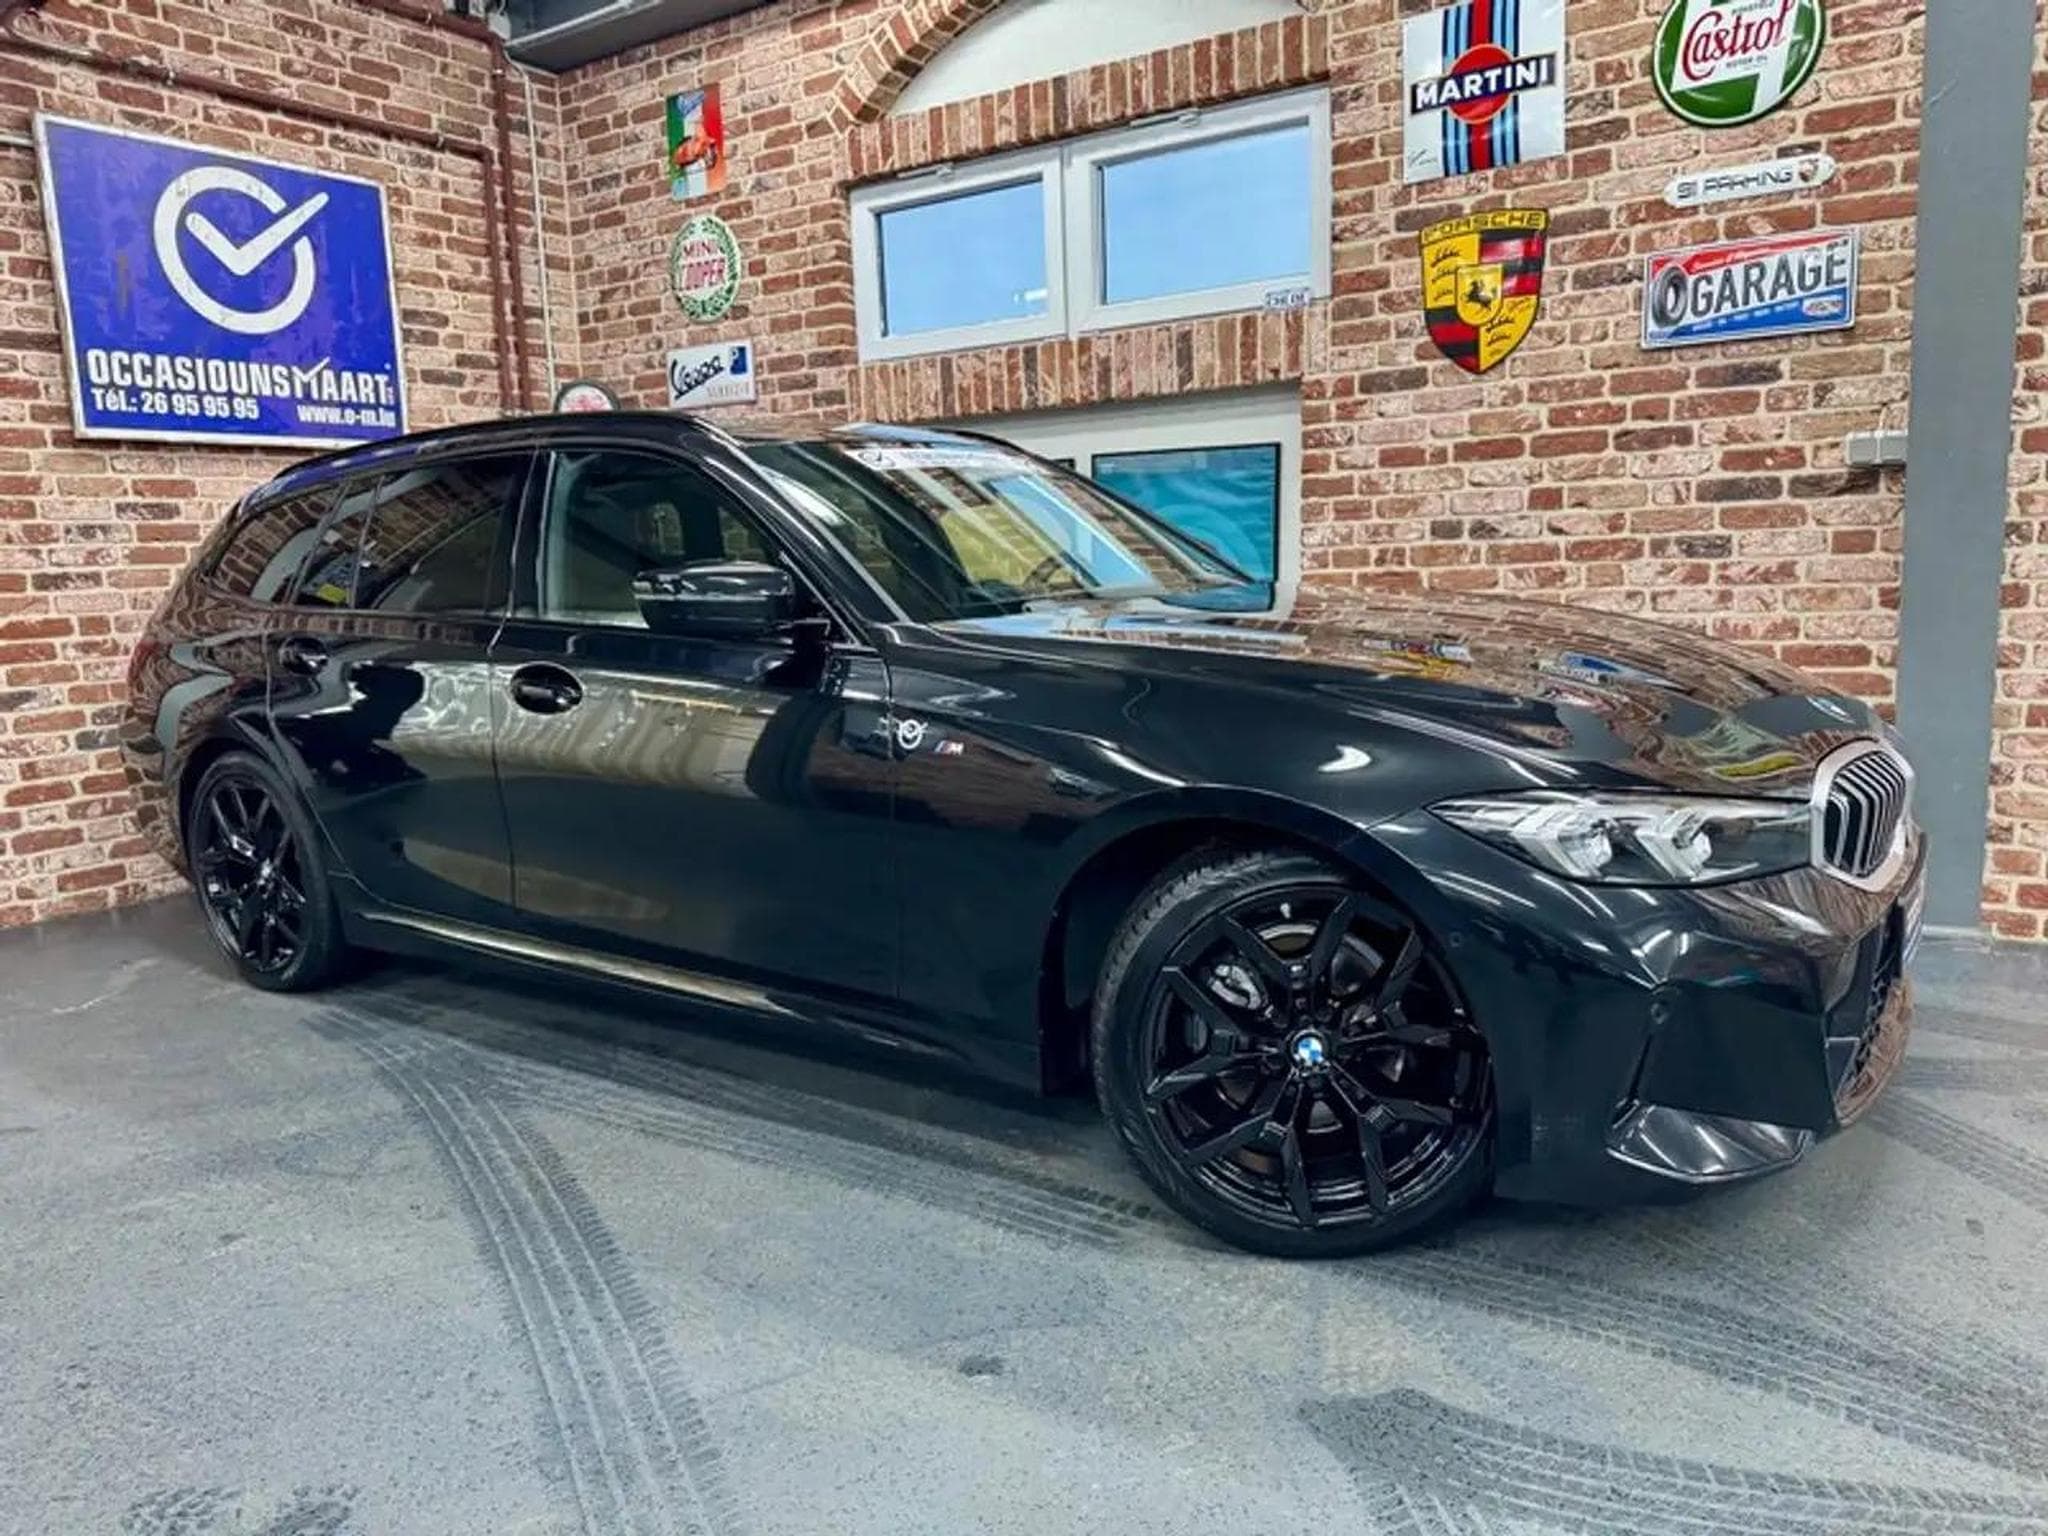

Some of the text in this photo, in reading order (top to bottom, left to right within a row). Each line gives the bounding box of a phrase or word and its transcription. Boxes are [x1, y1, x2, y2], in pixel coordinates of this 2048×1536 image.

[1682, 0, 1794, 81] Castrol
[1416, 59, 1548, 109] MARTINI
[1703, 167, 1793, 193] PARKING
[1424, 212, 1543, 242] PORSCHE
[1690, 239, 1848, 317] GARAGE
[141, 391, 168, 414] 26
[171, 393, 200, 416] 95
[203, 394, 230, 418] 95
[232, 397, 259, 420] 95
[297, 404, 396, 427] www.e-m.lu
